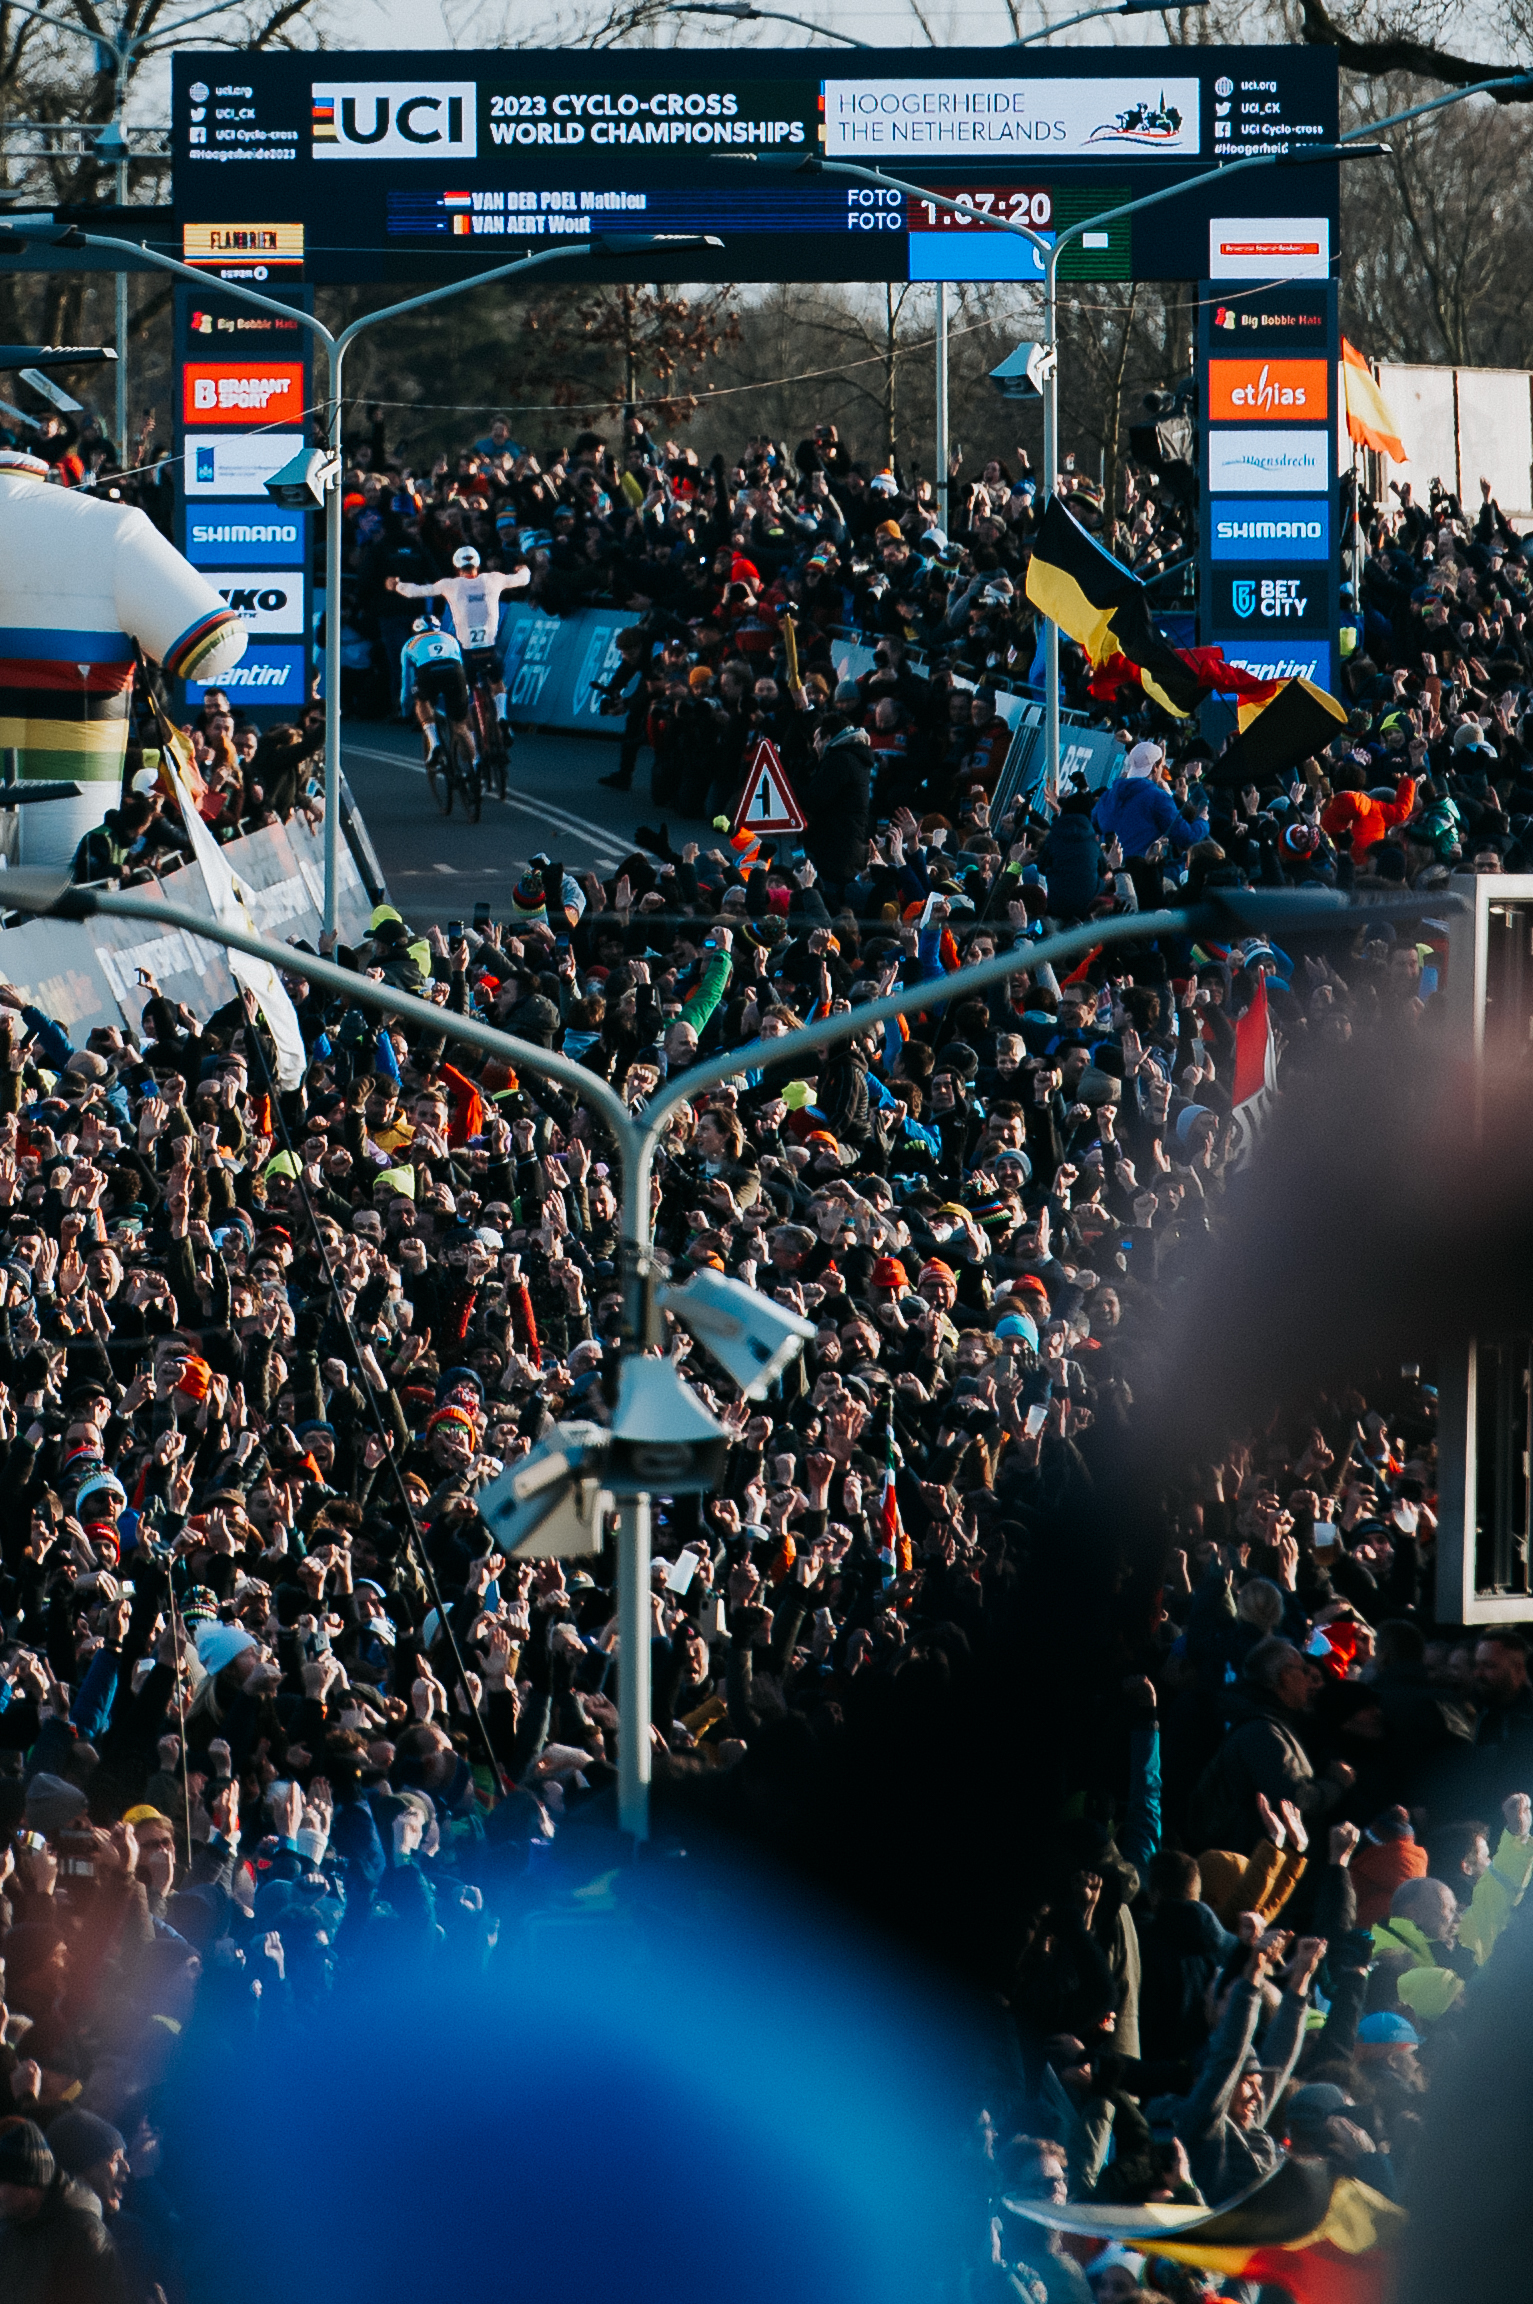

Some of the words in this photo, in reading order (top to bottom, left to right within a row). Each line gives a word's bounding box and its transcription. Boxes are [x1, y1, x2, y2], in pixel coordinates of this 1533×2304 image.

[215, 85, 253, 98] uci.org
[1241, 80, 1277, 93] uci.org
[490, 94, 547, 117] 2023
[551, 94, 738, 117] CYCLO-CROSS
[838, 93, 1026, 114] HOOGERHEIDE
[1241, 102, 1281, 115] UCI_CX
[215, 107, 256, 121] UCI_CX
[342, 97, 462, 144] UCI
[215, 129, 236, 141] UCI
[490, 121, 585, 144] WORLD
[590, 121, 805, 144] CHAMPIONSHIPS
[838, 121, 887, 142] THE
[891, 121, 1067, 142] NETHERLANDS
[1241, 123, 1260, 135] UCI
[1261, 123, 1324, 137] Cyclo-cross
[471, 191, 504, 211] VAN
[507, 191, 537, 211] DER
[540, 191, 577, 211] POEL
[580, 191, 647, 211] Mathieu
[847, 189, 902, 206] FOTO
[471, 215, 504, 234] VAN
[507, 215, 546, 234] AERT
[548, 215, 591, 234] Wout
[847, 212, 902, 230] FOTO
[1241, 314, 1259, 329] Big
[1261, 314, 1296, 326] Bobble
[218, 378, 292, 394] BRABANT
[1231, 364, 1307, 413] ethias
[218, 393, 273, 409] SPORT
[192, 525, 297, 543] SHIMANO
[1216, 521, 1322, 539] SHIMANO
[1260, 579, 1301, 599] BET
[1260, 598, 1308, 617] CITY
[469, 629, 487, 643] 27
[523, 619, 562, 662] BET
[433, 645, 444, 657] 9
